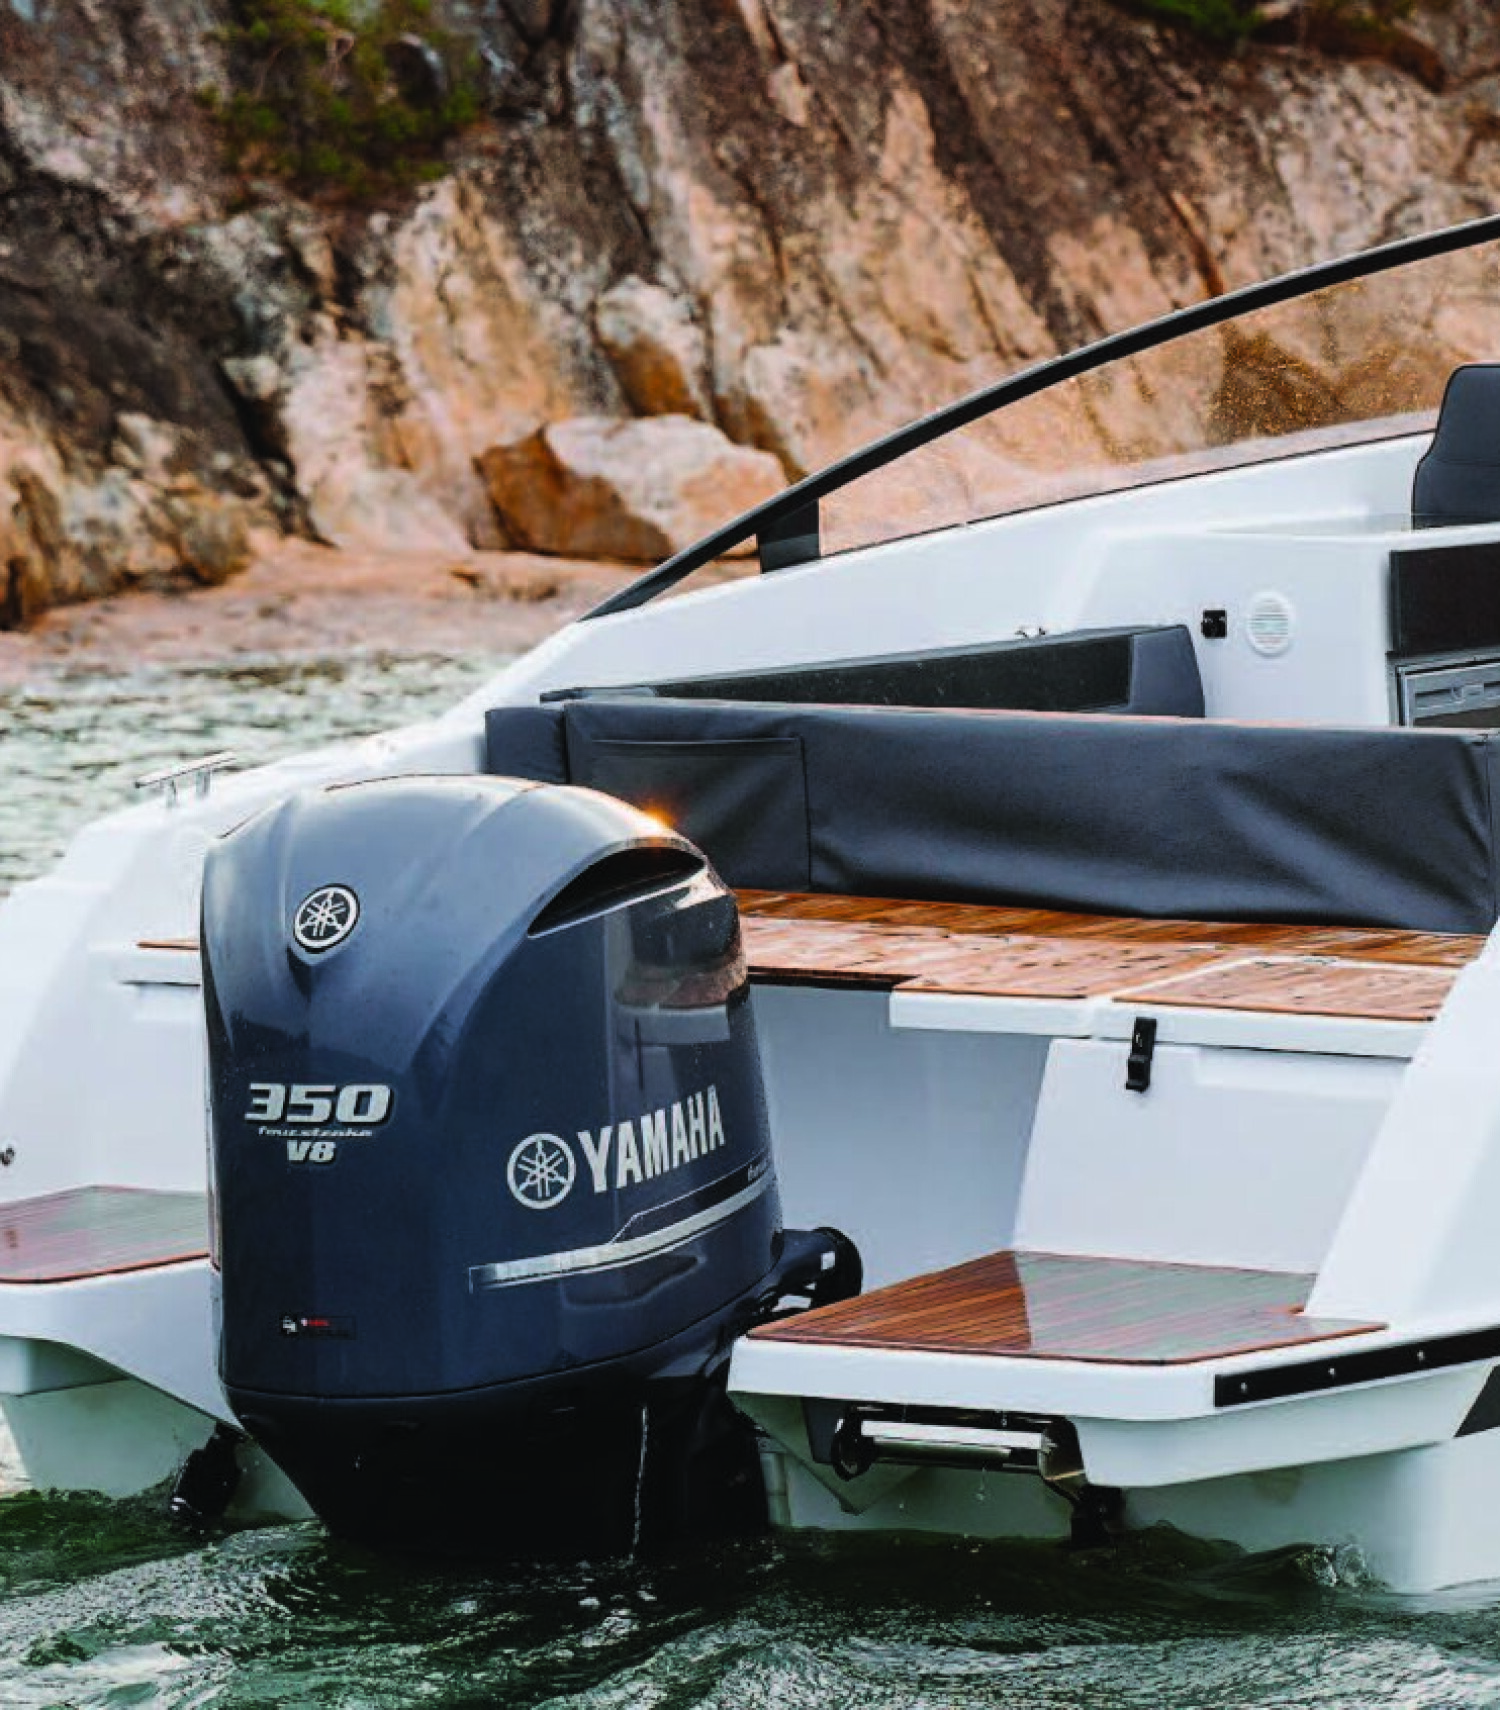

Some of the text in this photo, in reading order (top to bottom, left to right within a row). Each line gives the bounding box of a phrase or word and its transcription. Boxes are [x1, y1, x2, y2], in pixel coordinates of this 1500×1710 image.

[244, 1082, 391, 1123] 350
[286, 1140, 337, 1163] V8
[577, 1083, 726, 1194] YAMAHA
